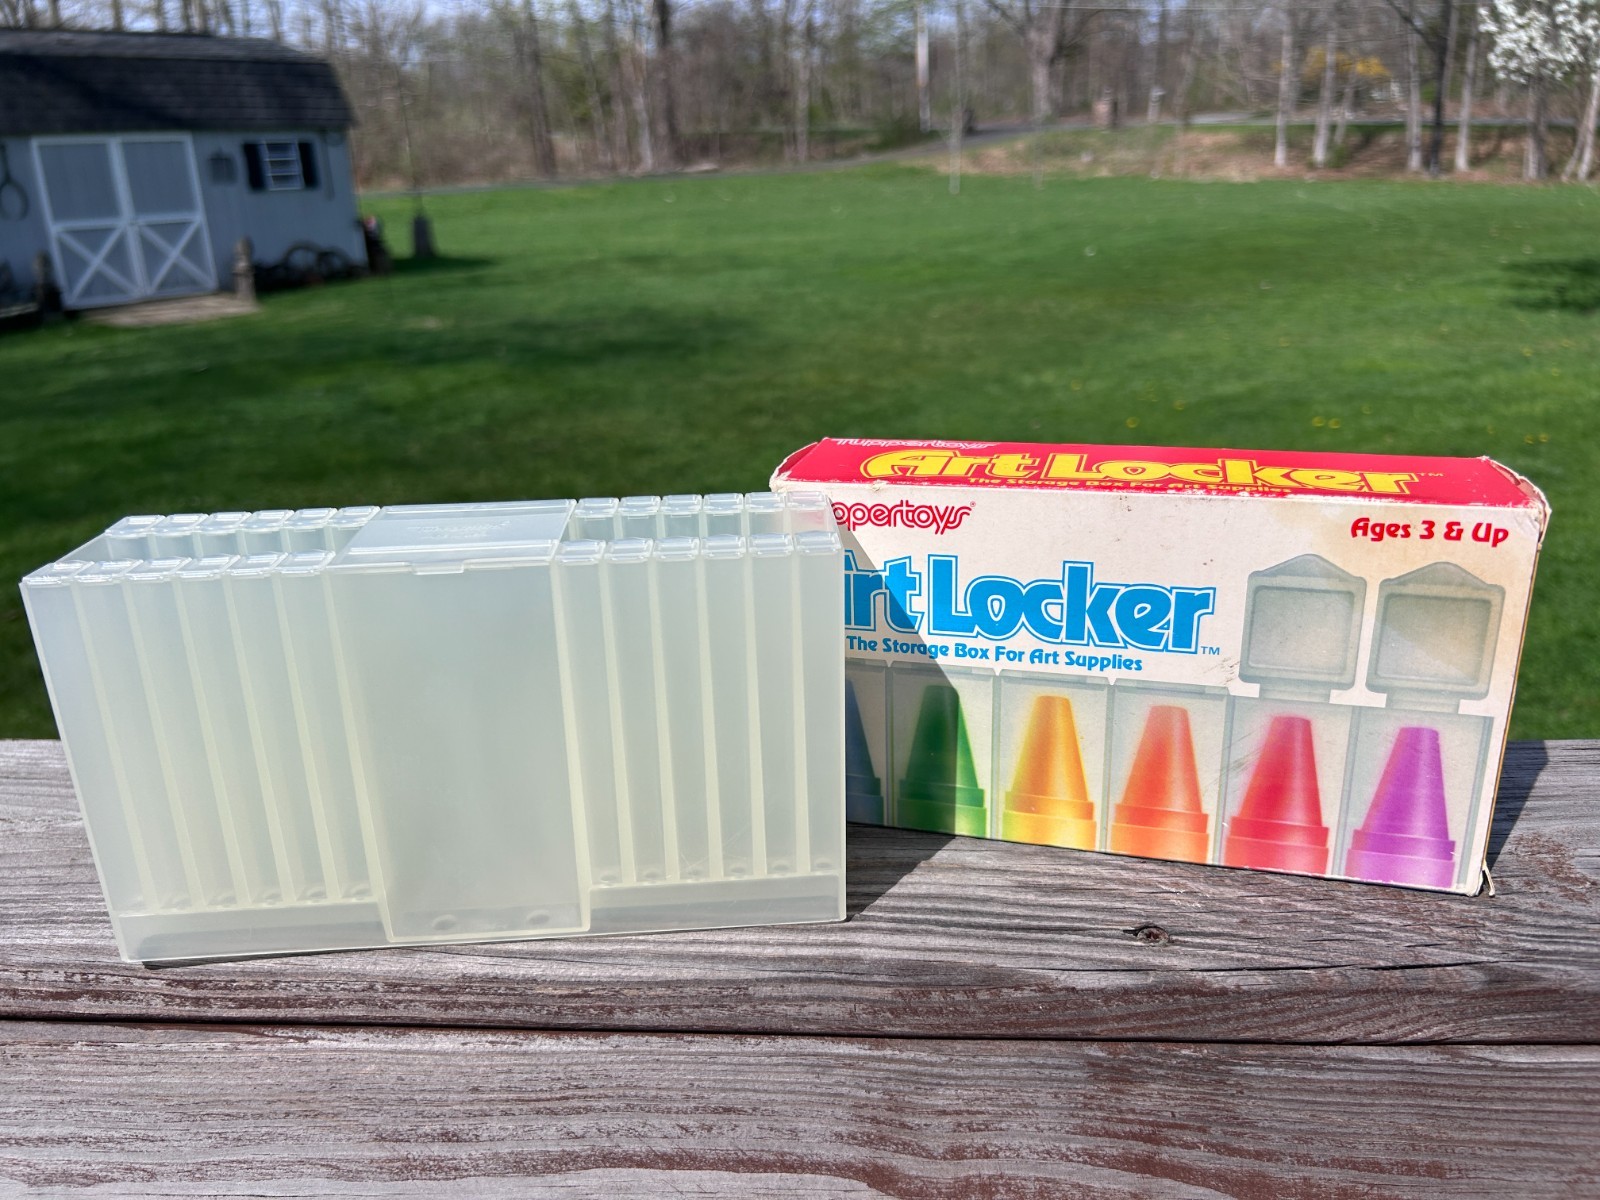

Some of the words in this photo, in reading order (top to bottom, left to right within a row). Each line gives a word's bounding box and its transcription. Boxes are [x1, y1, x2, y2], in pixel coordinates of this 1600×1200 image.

[859, 450, 1040, 478] Art
[1040, 453, 1419, 494] Locker
[1007, 478, 1079, 487] Storage
[1206, 484, 1292, 493] Supplies
[831, 499, 972, 535] ppertoys
[1350, 517, 1411, 542] Ages
[1419, 520, 1435, 540] 3
[1443, 521, 1464, 541] &
[1471, 522, 1509, 548] Up
[927, 553, 1217, 654] Locker
[846, 635, 878, 652] The
[882, 637, 950, 660] Storage
[954, 643, 989, 660] Box
[995, 645, 1025, 662] For
[1029, 648, 1060, 665] Art
[1064, 650, 1143, 672] Supplies
